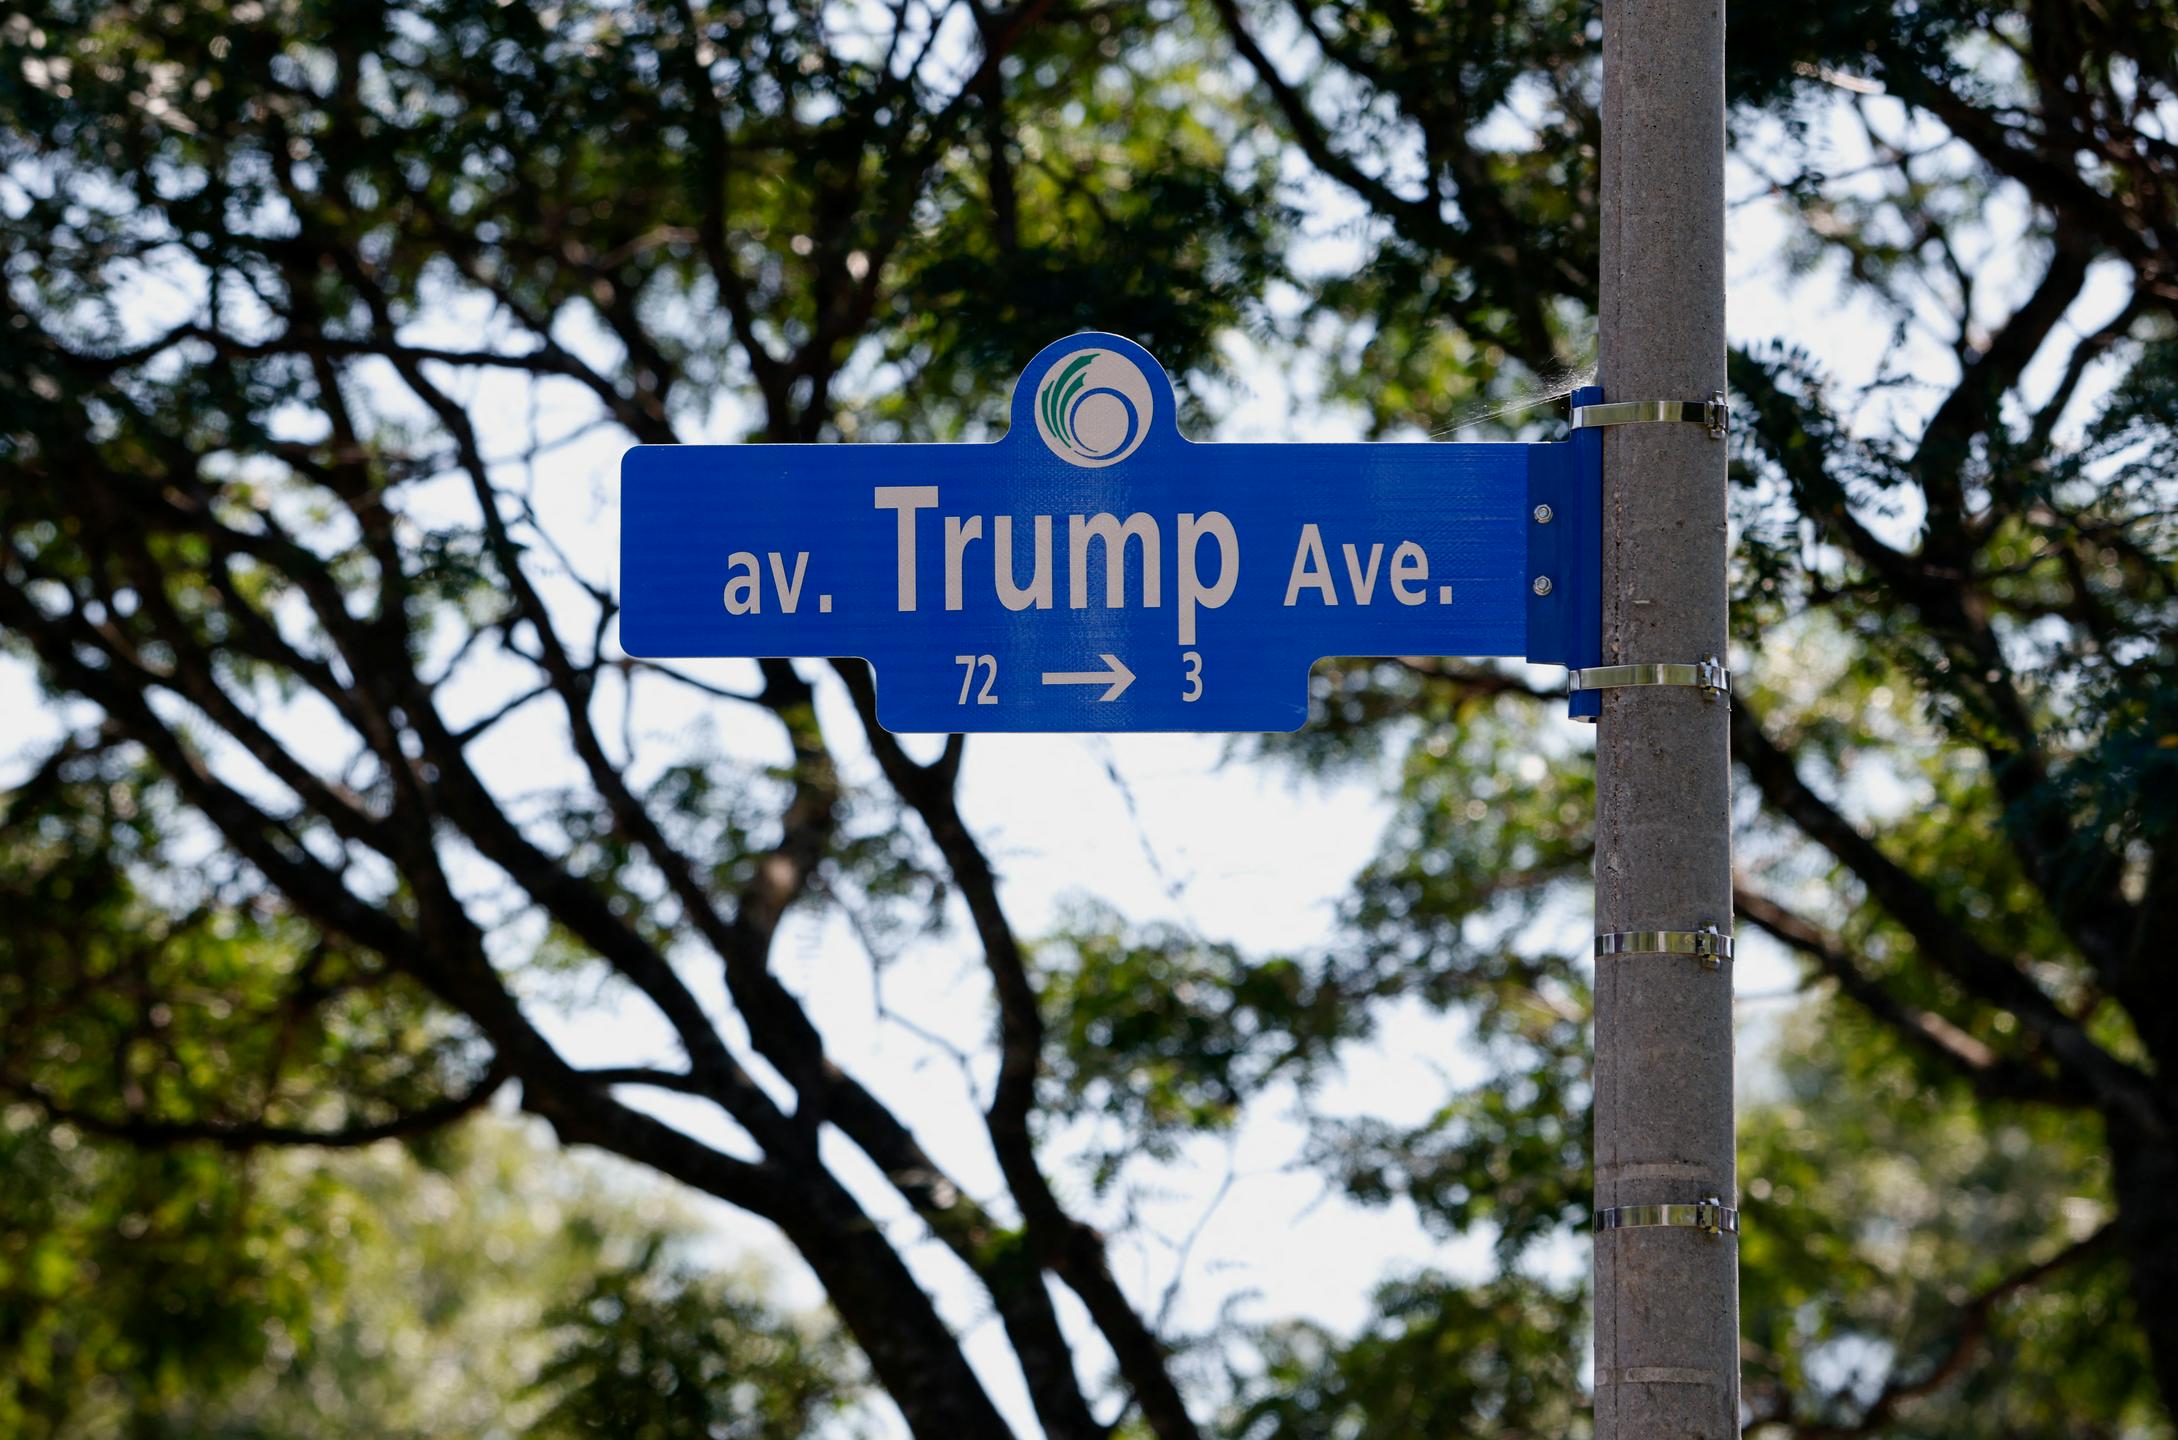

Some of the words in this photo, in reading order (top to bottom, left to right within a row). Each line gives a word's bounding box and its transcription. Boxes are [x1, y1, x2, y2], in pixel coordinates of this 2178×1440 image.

[723, 551, 832, 616] av.
[874, 485, 1240, 646] Trump
[1283, 523, 1453, 606] Ave.
[955, 654, 998, 705] 72
[1182, 651, 1203, 702] 3
